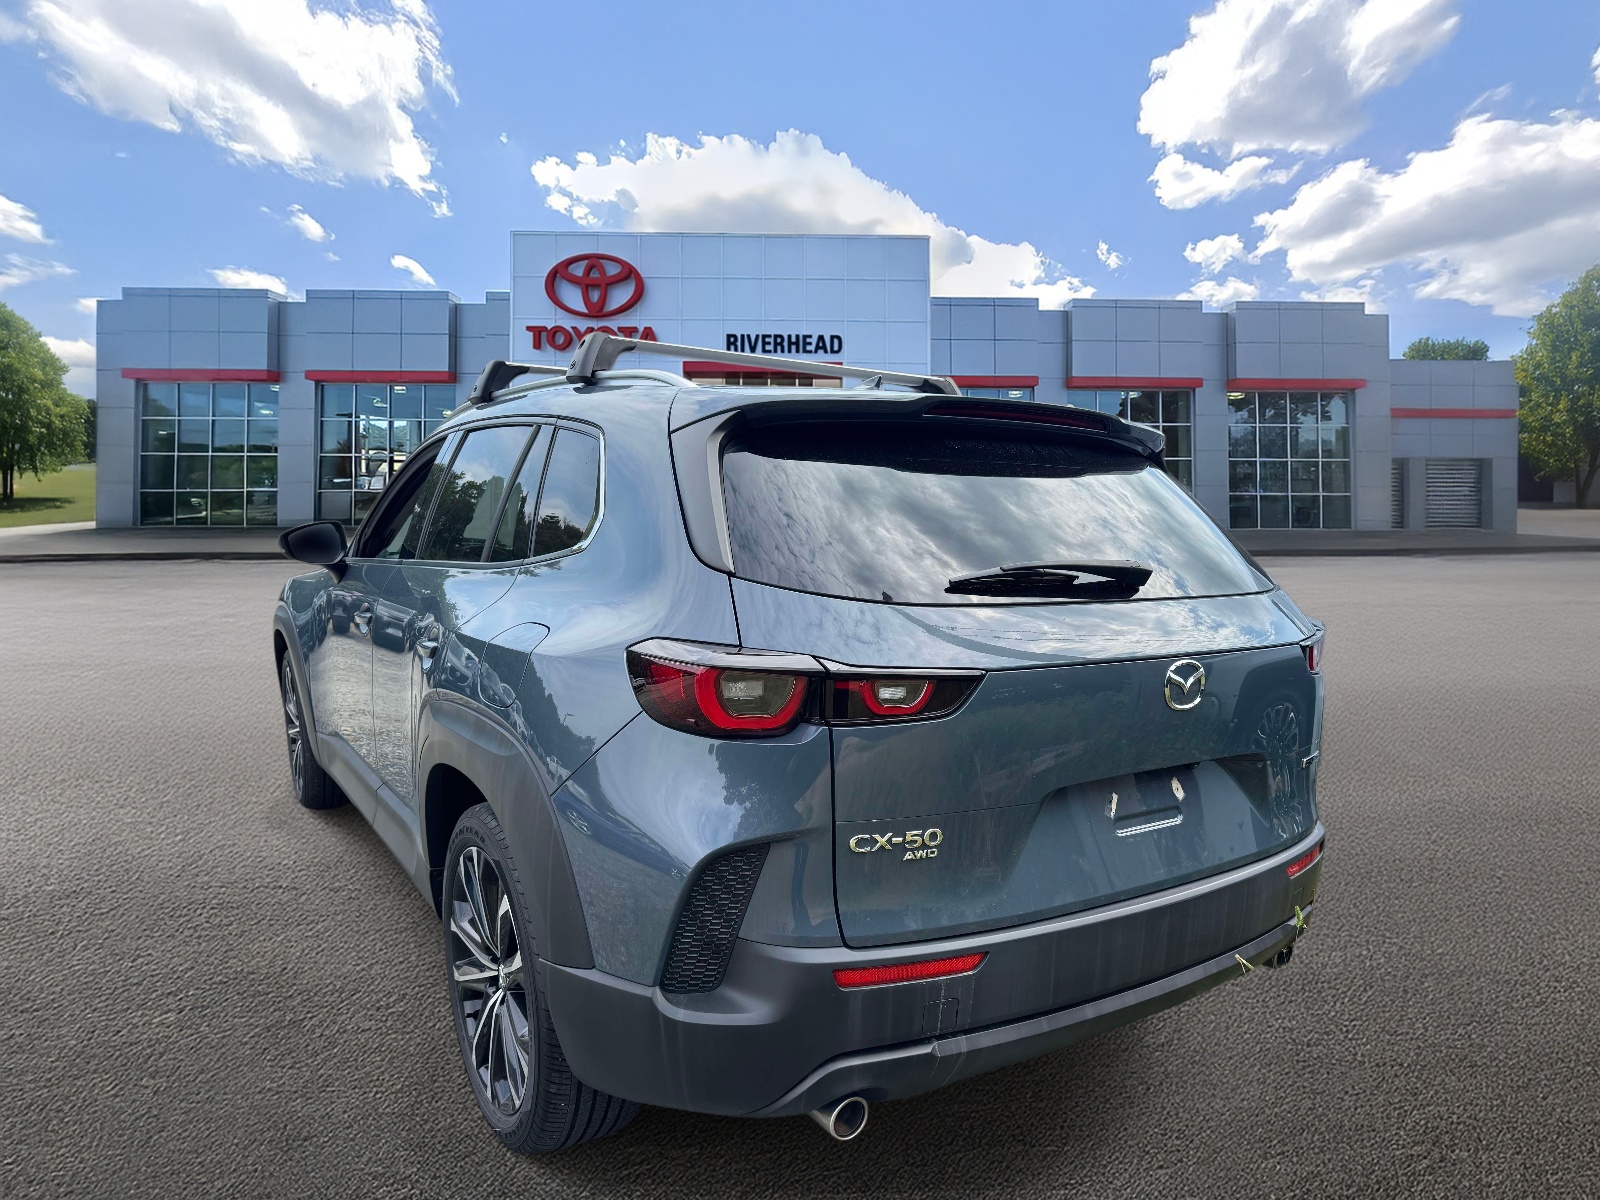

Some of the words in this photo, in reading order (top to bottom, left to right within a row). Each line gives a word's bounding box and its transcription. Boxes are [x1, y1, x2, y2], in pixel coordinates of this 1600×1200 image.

[525, 325, 658, 351] TOYTA
[726, 333, 843, 354] RIVERHEAD
[849, 828, 944, 853] CX-50
[902, 848, 938, 861] AWD
